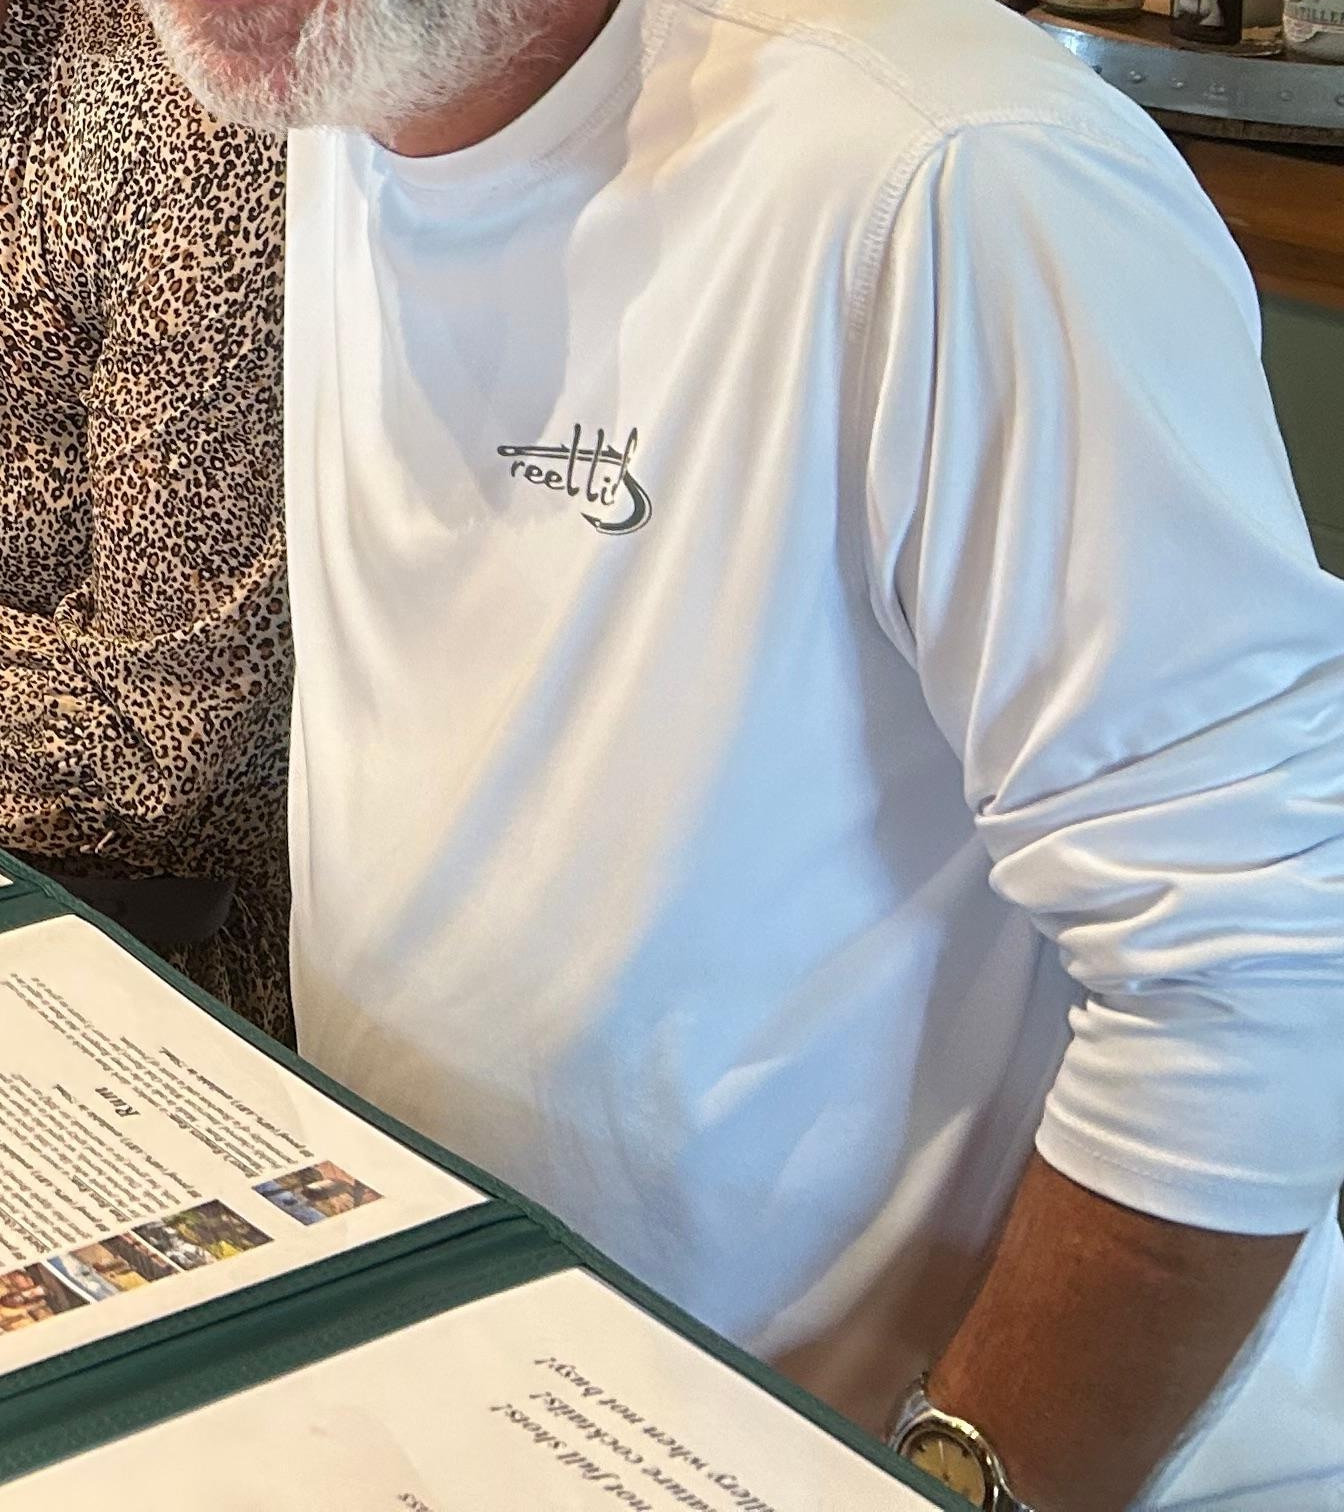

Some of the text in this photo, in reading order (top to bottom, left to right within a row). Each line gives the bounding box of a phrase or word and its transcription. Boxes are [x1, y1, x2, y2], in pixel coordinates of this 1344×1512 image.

[95, 1087, 141, 1118] Rum
[534, 1357, 604, 1398] busy!
[489, 1402, 566, 1451] shots!
[528, 1390, 645, 1465] cocktails!
[600, 1397, 645, 1426] not
[558, 1450, 614, 1481] full
[642, 1423, 711, 1471] when
